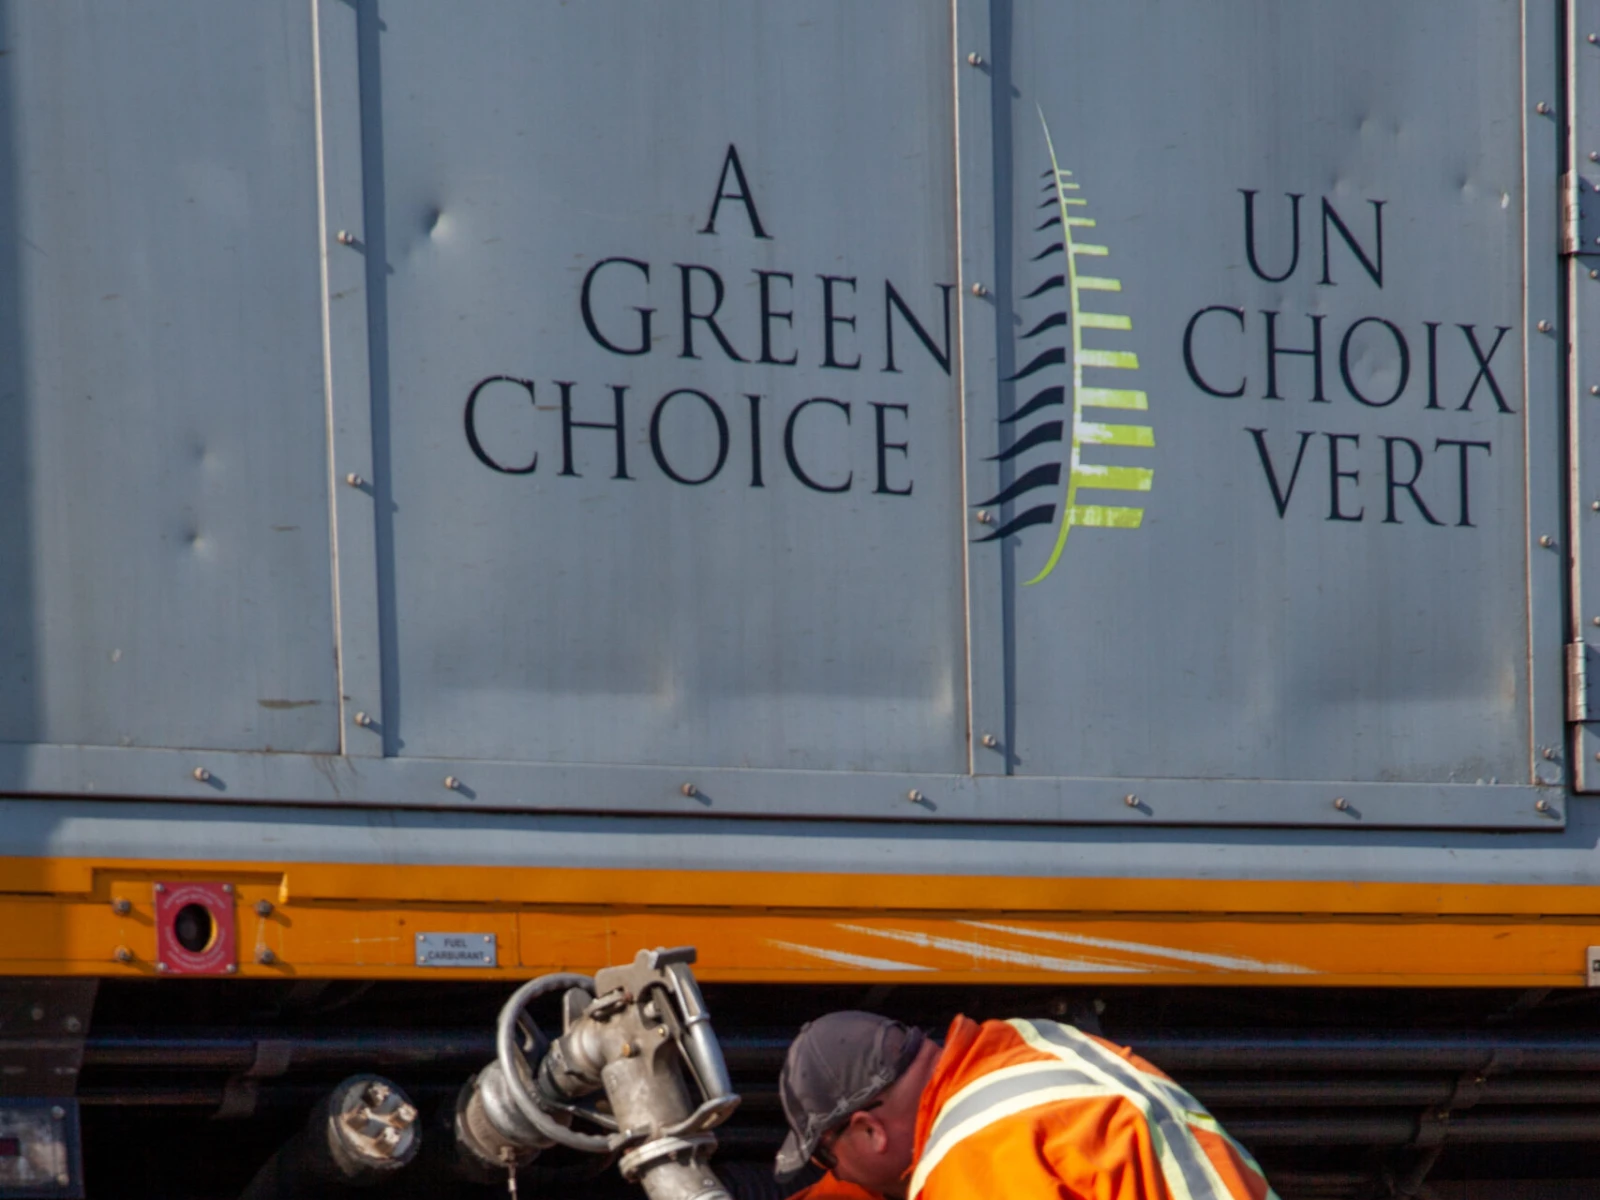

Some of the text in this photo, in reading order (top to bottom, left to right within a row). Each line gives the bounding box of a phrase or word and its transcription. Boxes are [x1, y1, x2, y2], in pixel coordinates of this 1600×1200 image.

[697, 143, 774, 240] A
[1237, 188, 1388, 289] UN
[580, 257, 957, 376] GREEN
[1182, 305, 1517, 414] CHOIX
[464, 375, 914, 496] CHOICE
[1244, 427, 1492, 528] VERT
[427, 950, 485, 960] CARBURANT
[443, 938, 468, 949] FUEL
